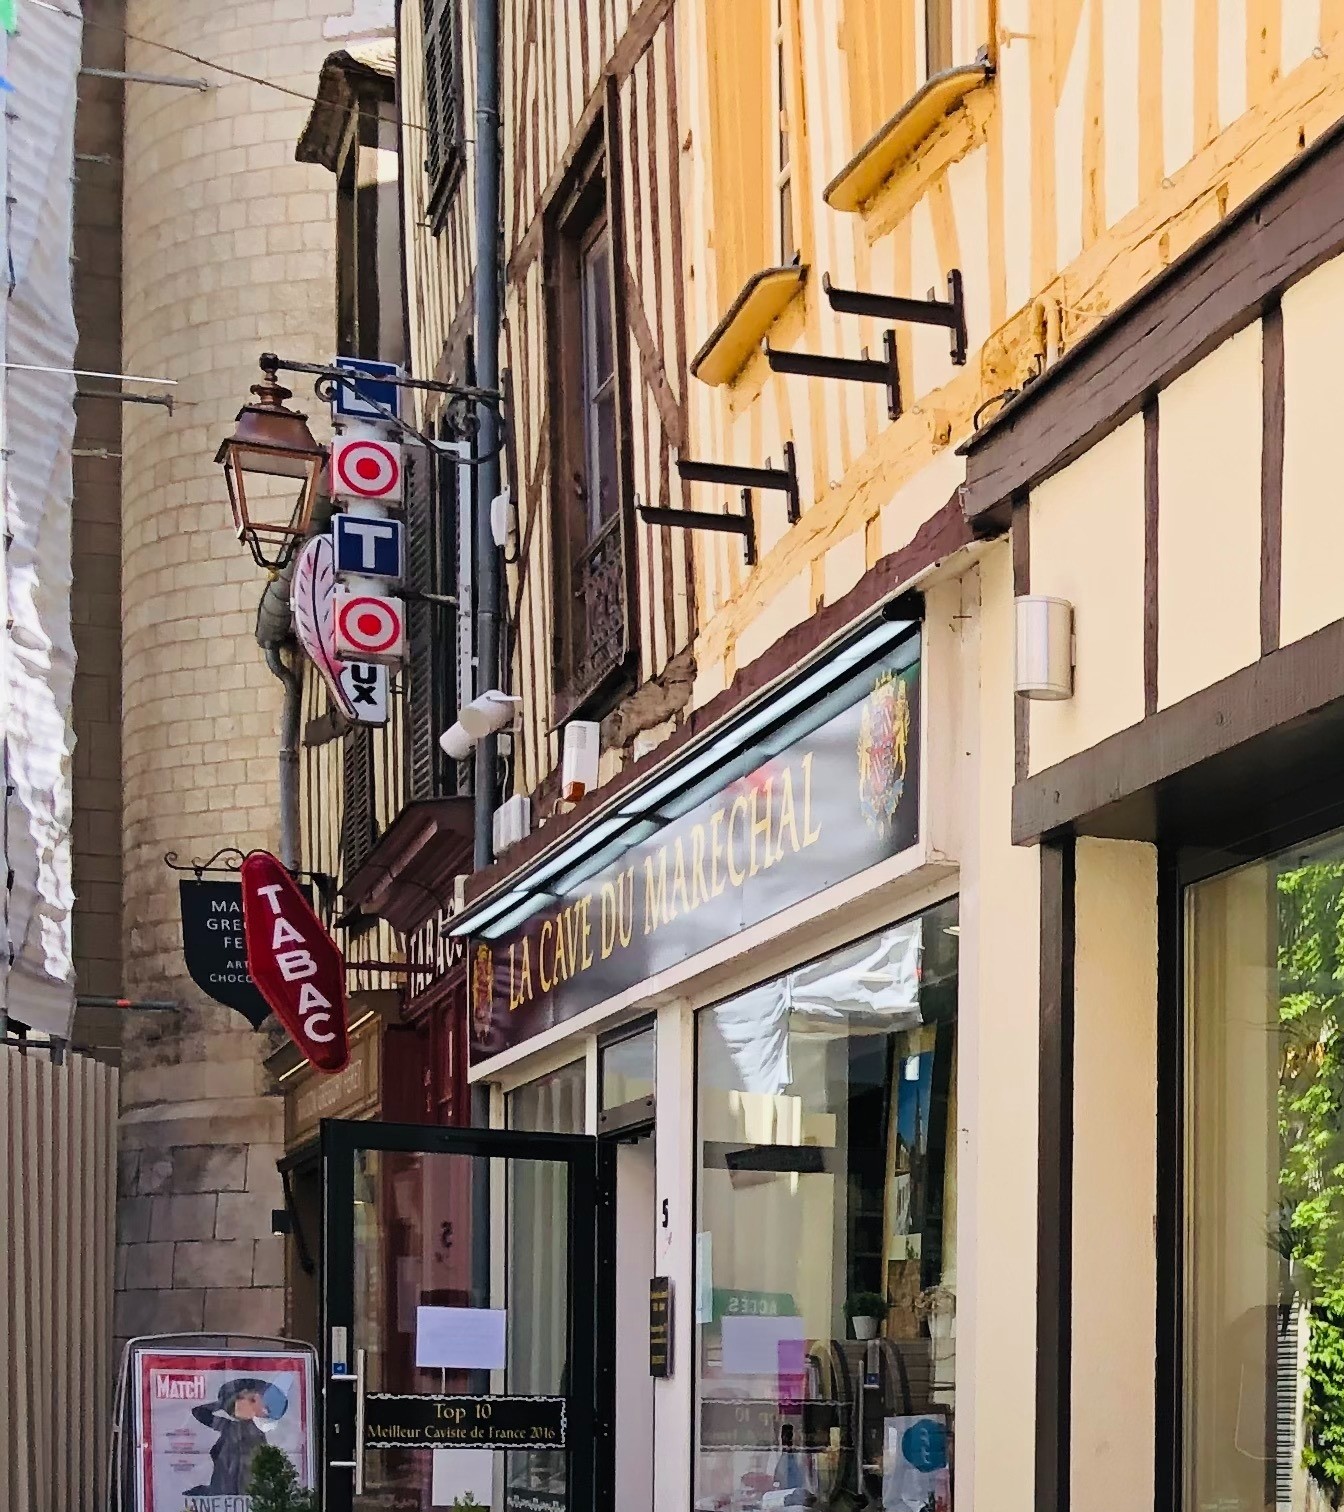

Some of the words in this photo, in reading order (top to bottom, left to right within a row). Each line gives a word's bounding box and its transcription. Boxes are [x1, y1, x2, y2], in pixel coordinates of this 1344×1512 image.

[508, 935, 534, 1012] LA
[539, 900, 593, 993] CAVE
[600, 868, 633, 960] DU
[257, 884, 336, 1042] TABAC
[662, 1198, 669, 1229] 5
[156, 1373, 205, 1399] MATCH
[434, 1403, 466, 1424] Top
[475, 1403, 492, 1419] 10
[367, 1425, 421, 1439] Meilleur
[425, 1425, 467, 1439] Caviste
[470, 1426, 485, 1439] de
[489, 1426, 526, 1439] France
